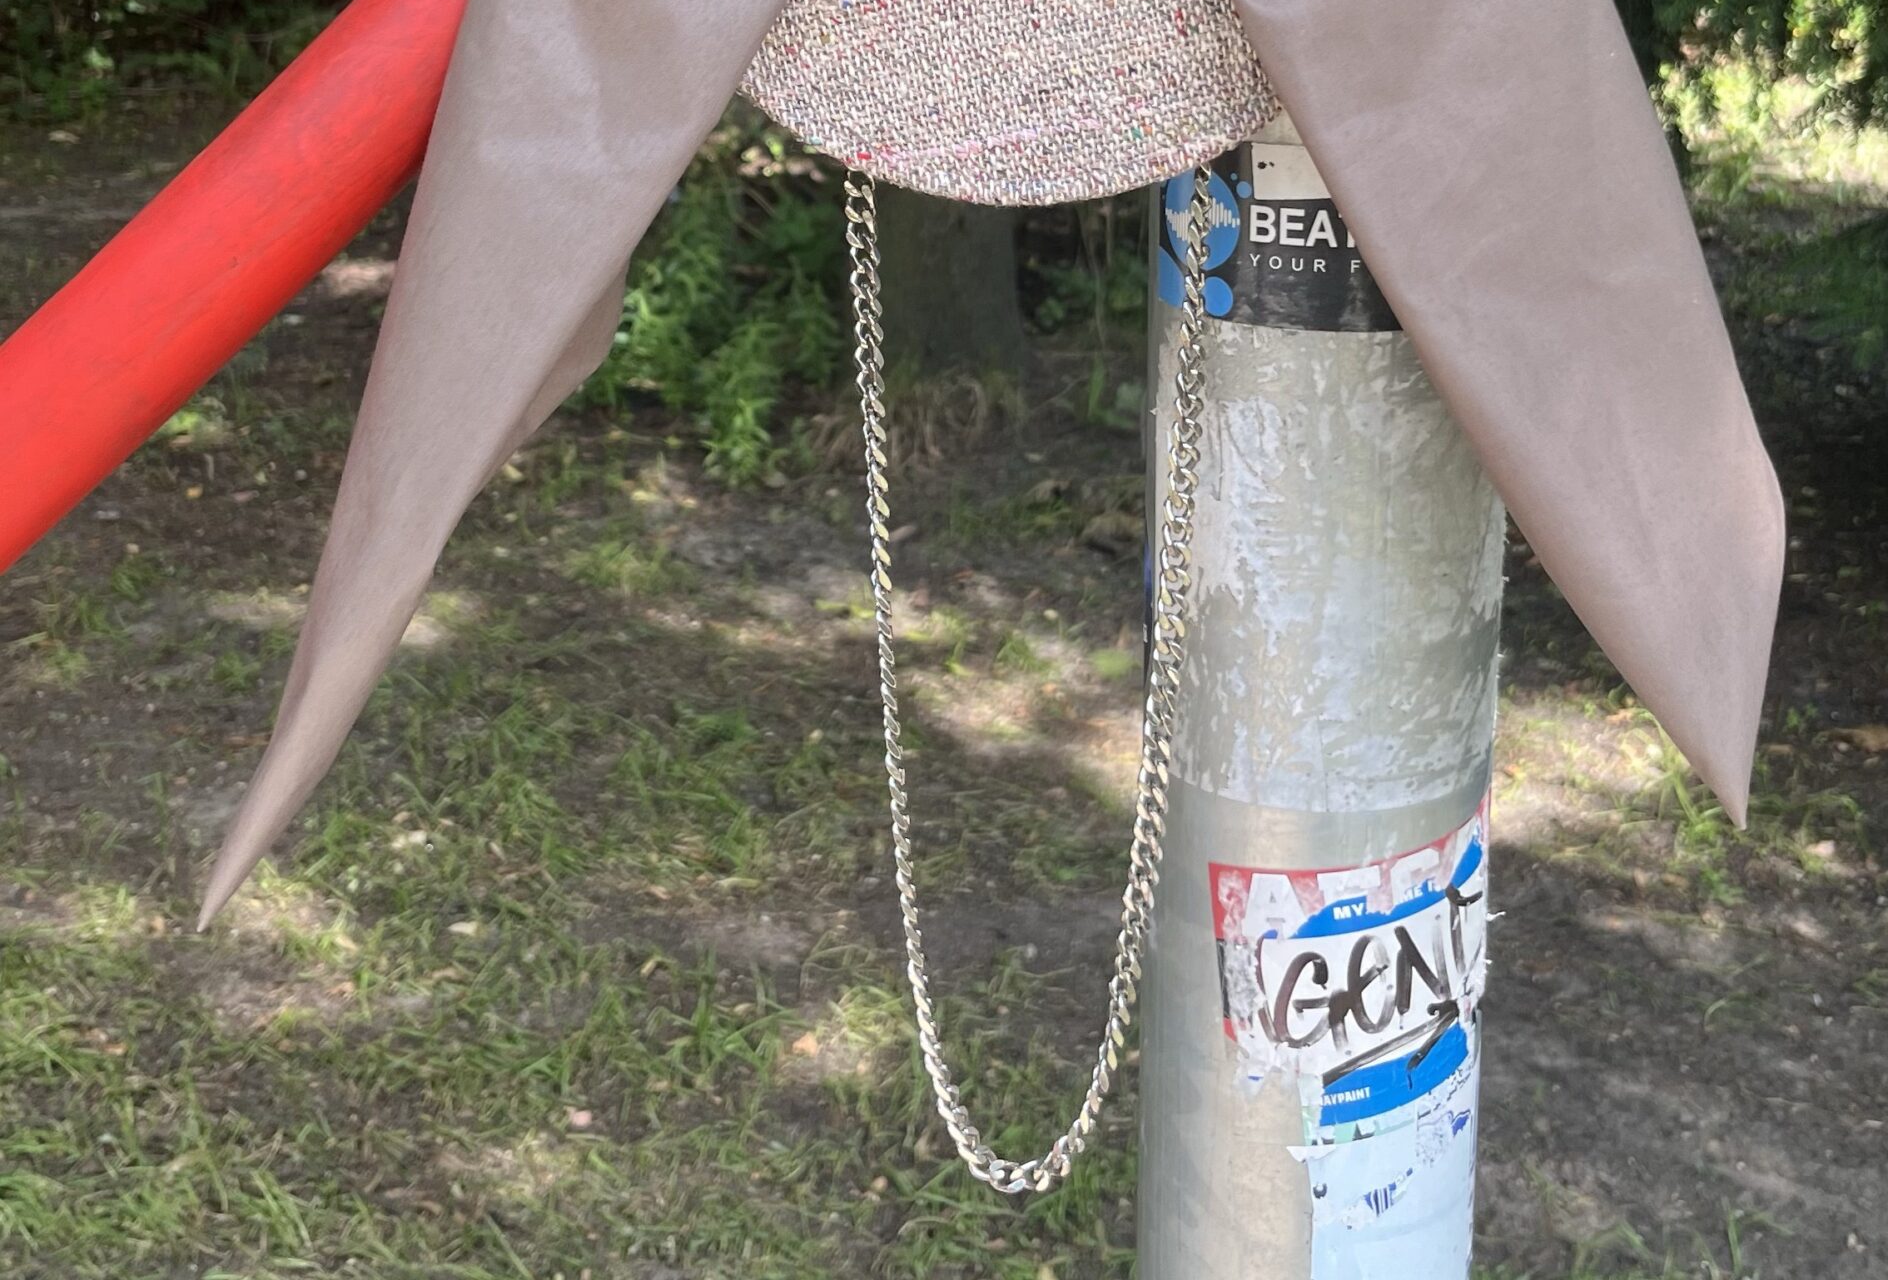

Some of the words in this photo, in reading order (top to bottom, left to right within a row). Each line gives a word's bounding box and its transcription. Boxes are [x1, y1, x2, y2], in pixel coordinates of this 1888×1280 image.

[1249, 253, 1327, 273] YOUR
[1333, 902, 1365, 921] MY
[1320, 1086, 1371, 1107] AYPAINT
